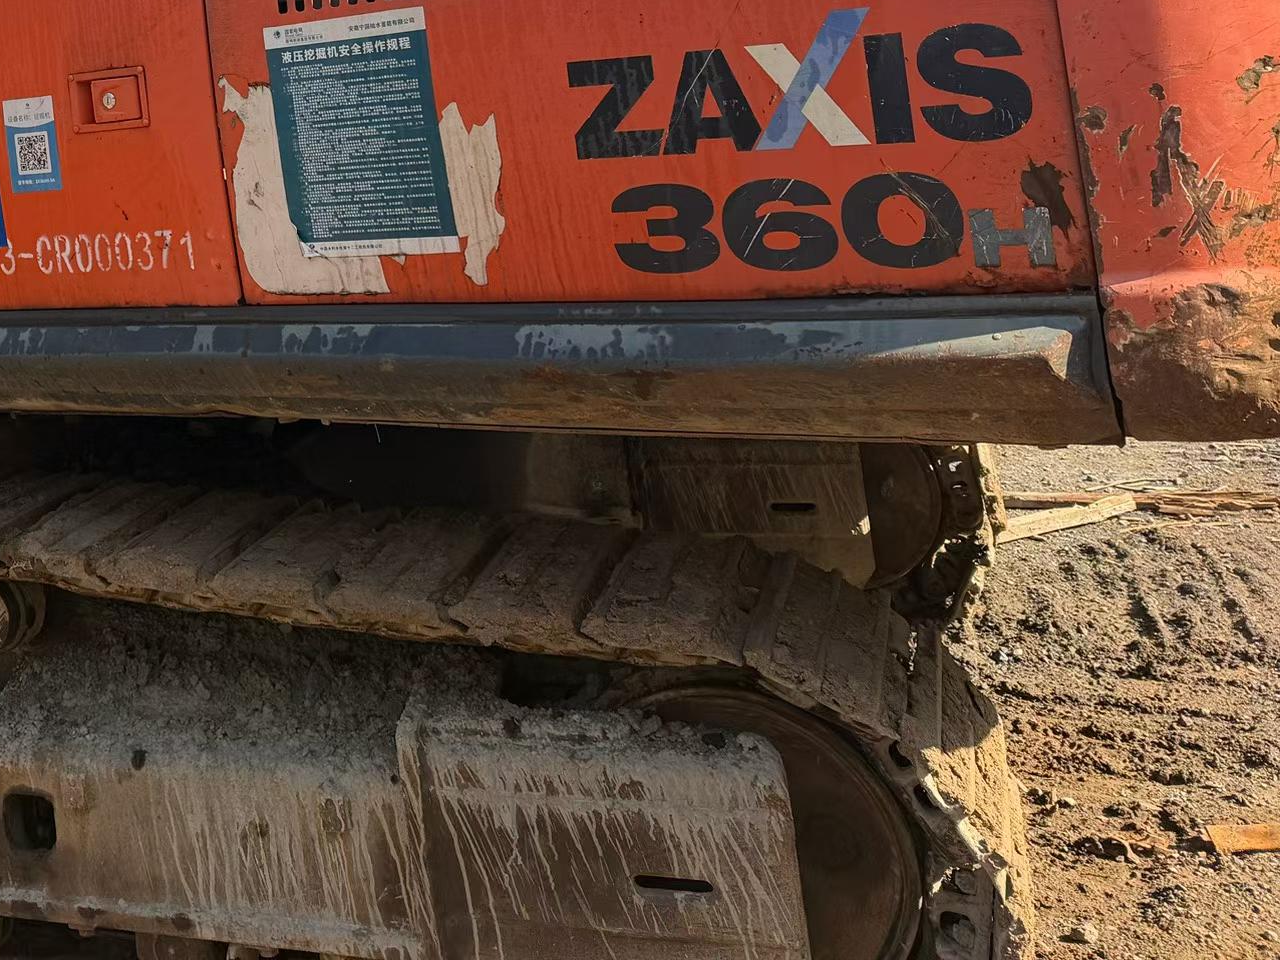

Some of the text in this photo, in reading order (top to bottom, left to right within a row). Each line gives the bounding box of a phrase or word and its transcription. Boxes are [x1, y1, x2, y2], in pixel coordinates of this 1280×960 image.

[281, 36, 412, 64] 液压挖掘机安全操作规程
[567, 7, 1033, 160] ZAXIS
[0, 229, 195, 276] 3-CR000371
